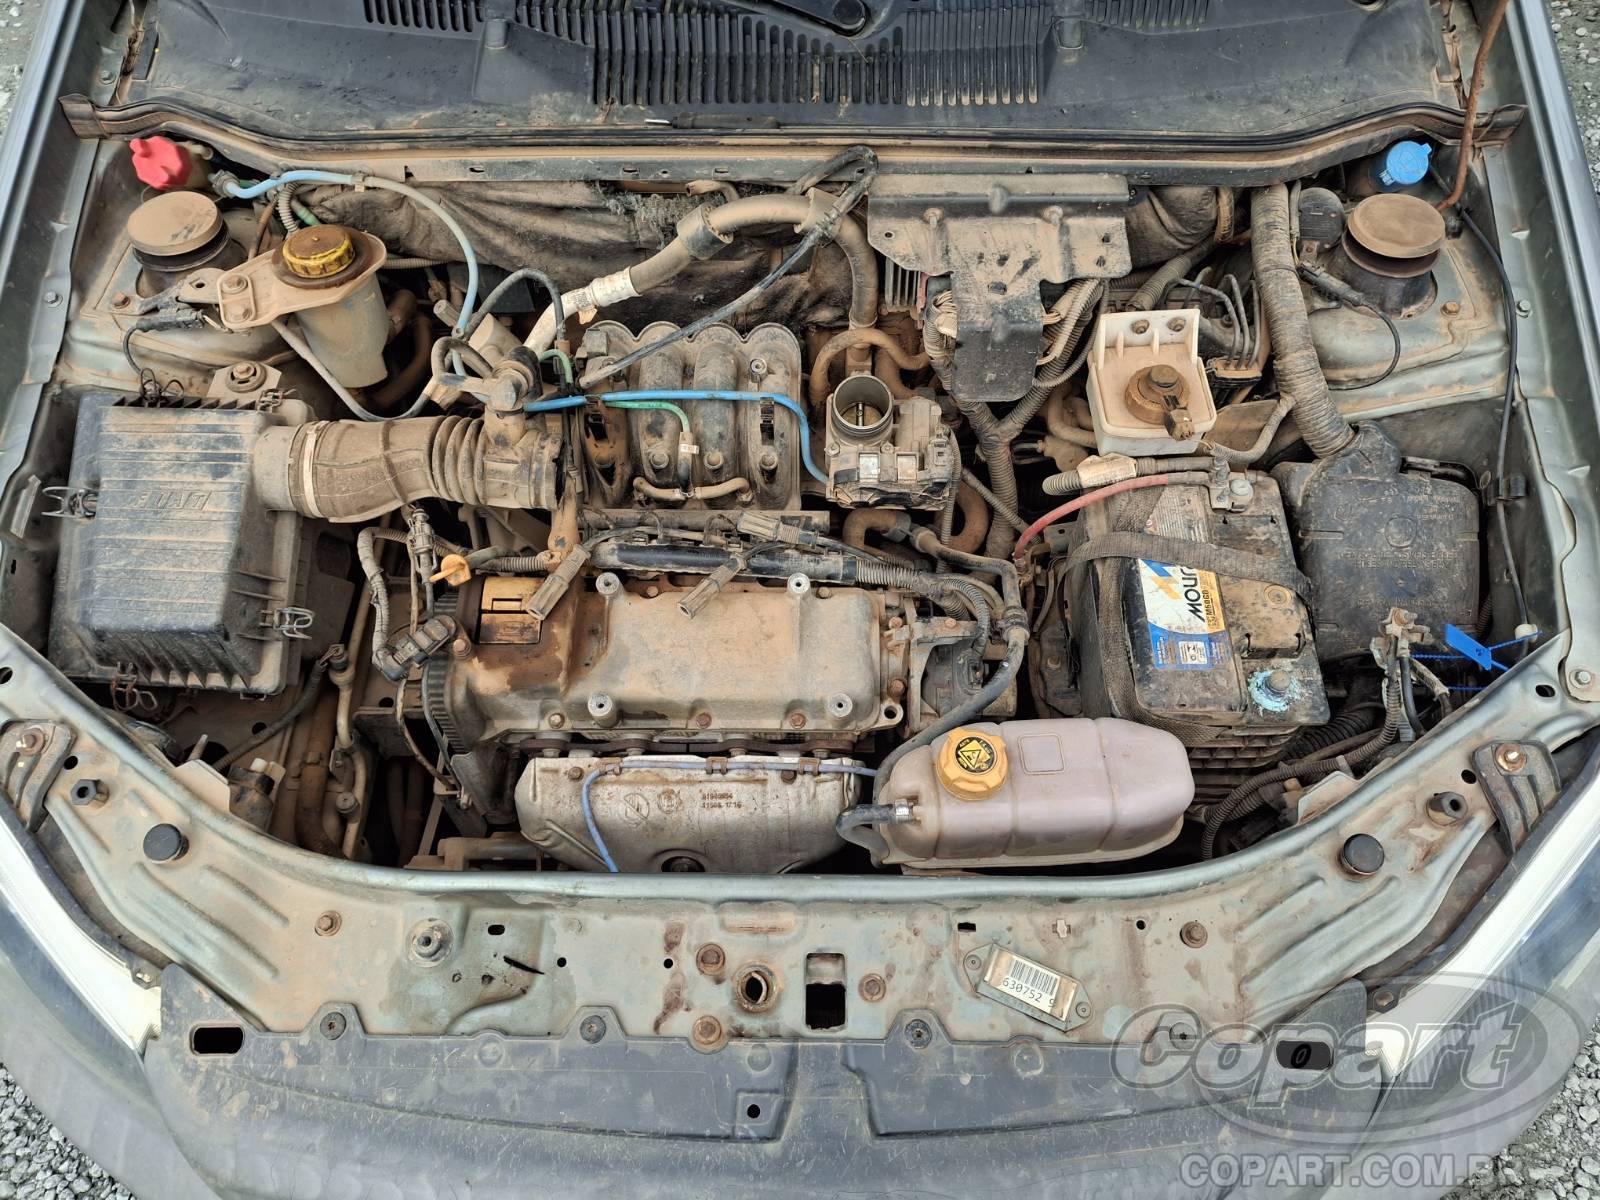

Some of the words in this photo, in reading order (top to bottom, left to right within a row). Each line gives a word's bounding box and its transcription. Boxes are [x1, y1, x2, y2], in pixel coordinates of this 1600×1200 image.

[131, 488, 211, 510] FIAT
[1180, 566, 1205, 623] MOUR
[1002, 977, 1043, 1003] 630752
